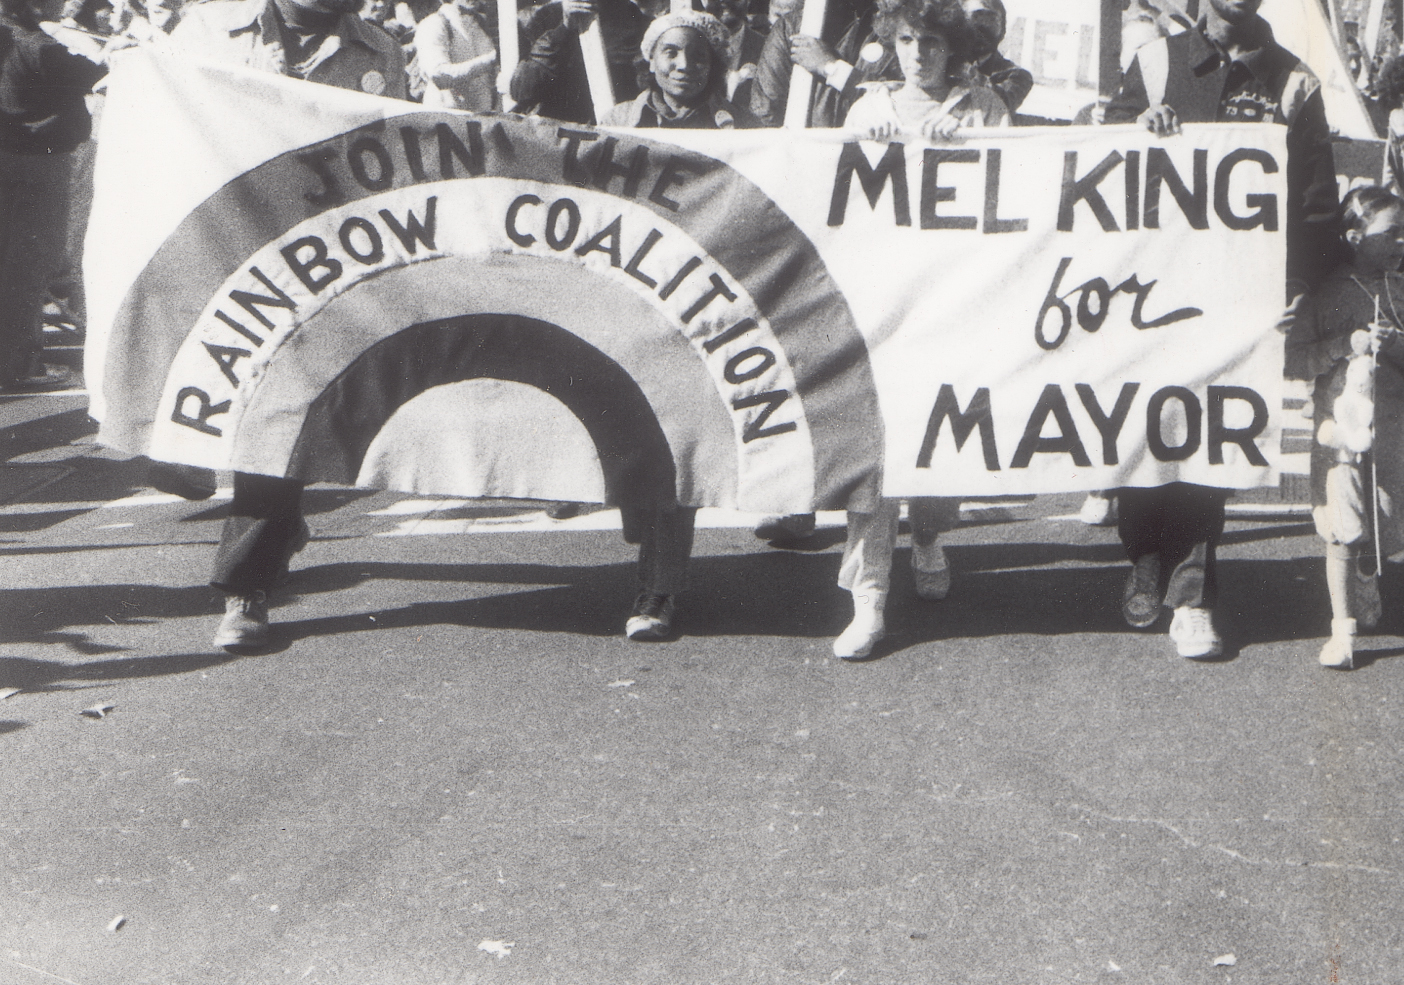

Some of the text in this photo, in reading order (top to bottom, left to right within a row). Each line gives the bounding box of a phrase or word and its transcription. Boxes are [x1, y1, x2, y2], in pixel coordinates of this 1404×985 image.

[301, 121, 700, 213] JOIN THE
[827, 142, 1279, 234] MEL KING
[171, 193, 798, 445] RAINBOW COALITION
[1035, 257, 1204, 351] for
[915, 382, 1269, 471] MAYOR
